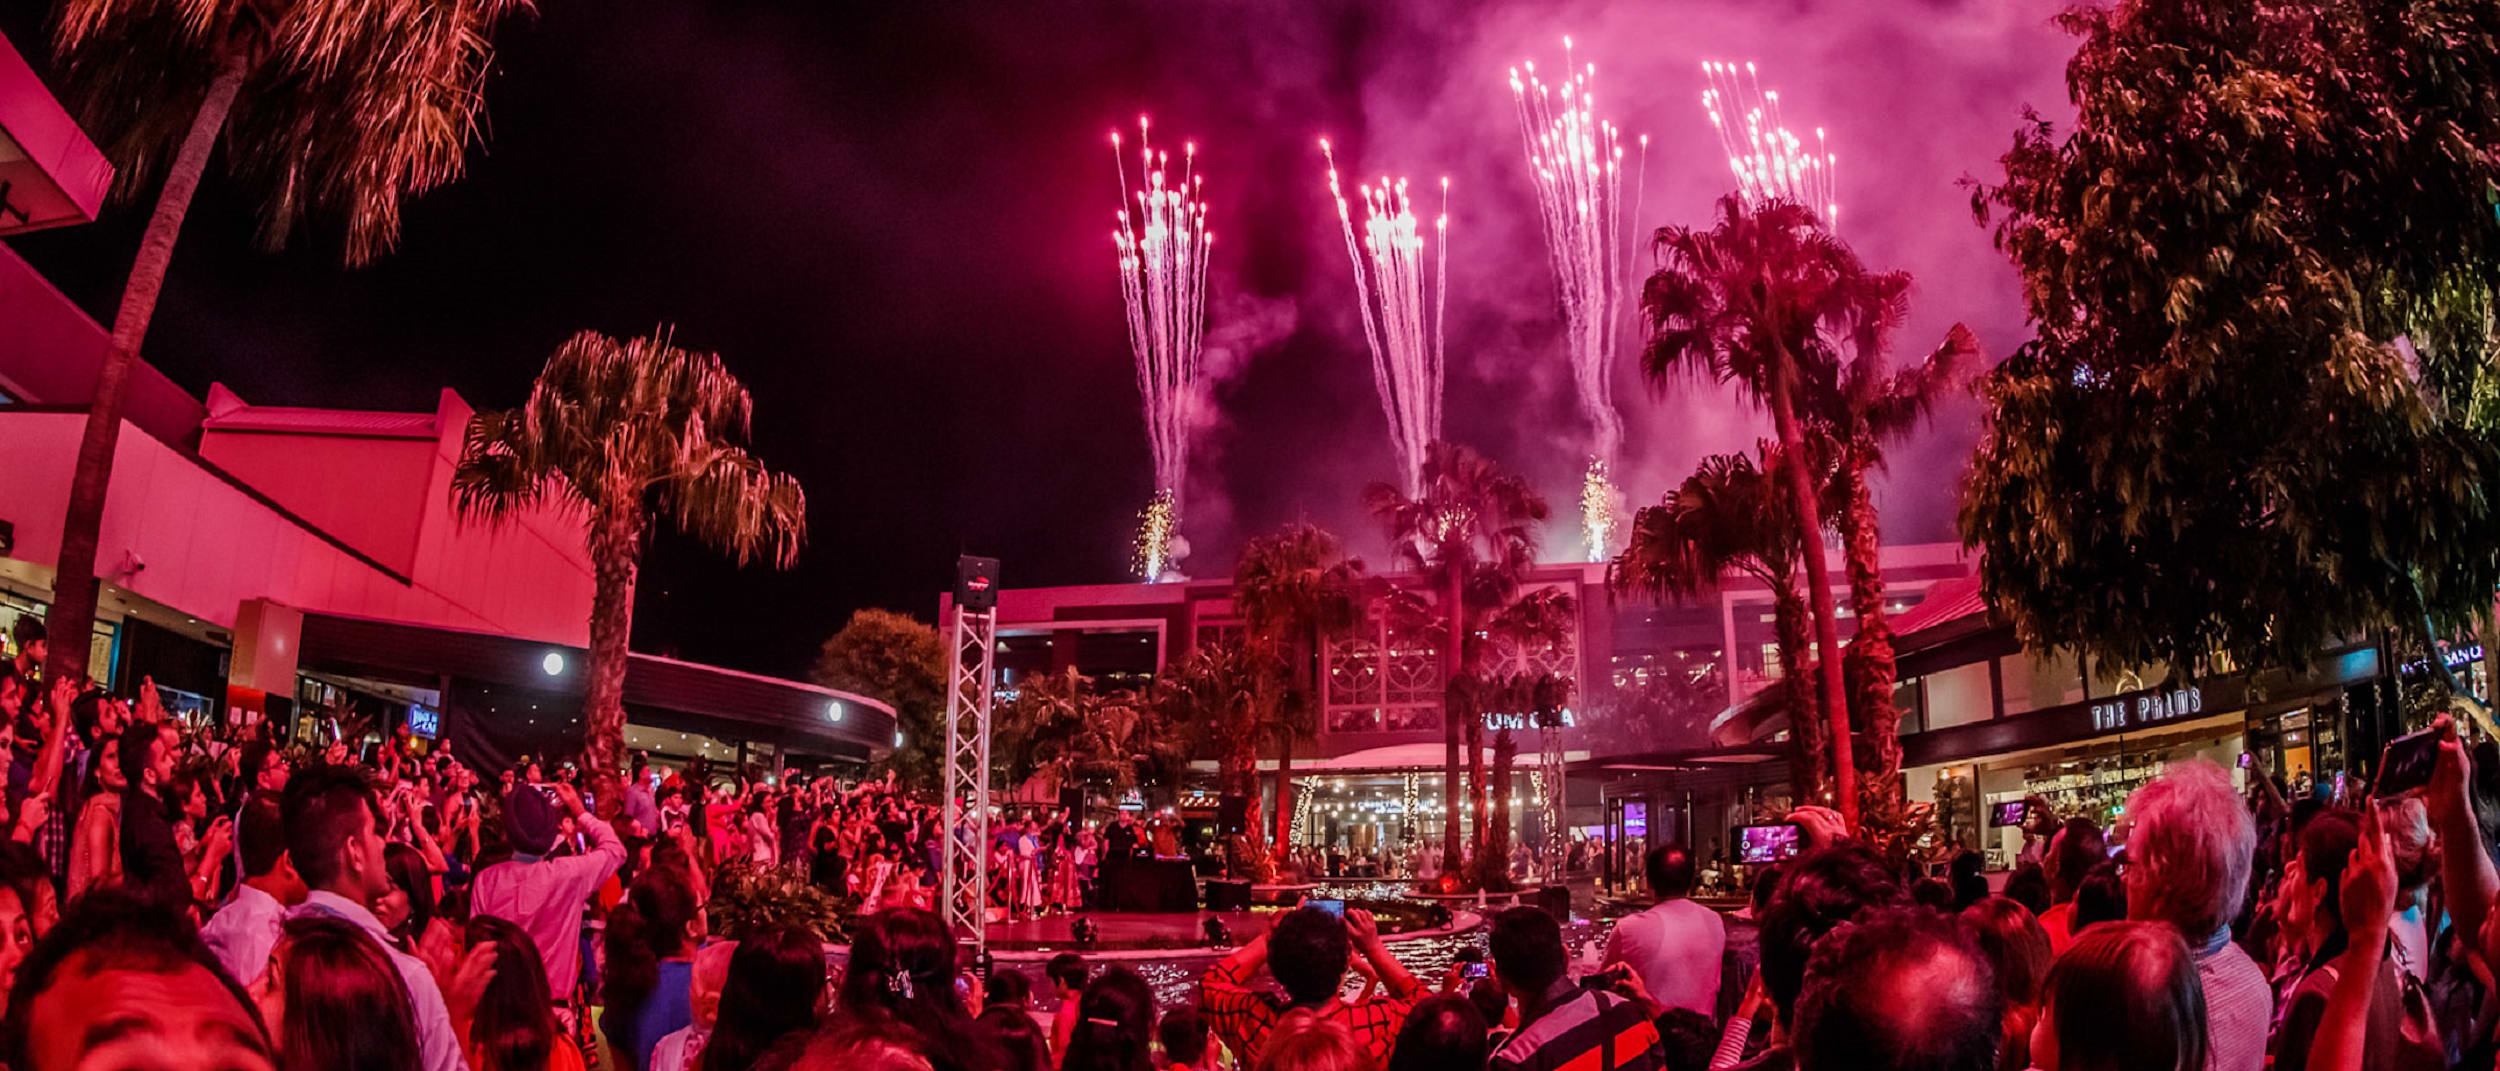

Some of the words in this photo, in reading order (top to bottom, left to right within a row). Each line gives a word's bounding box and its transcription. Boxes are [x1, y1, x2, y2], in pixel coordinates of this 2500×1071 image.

[1529, 708, 1575, 729] CA
[2091, 702, 2126, 731] THE
[2138, 687, 2201, 722] PALMS
